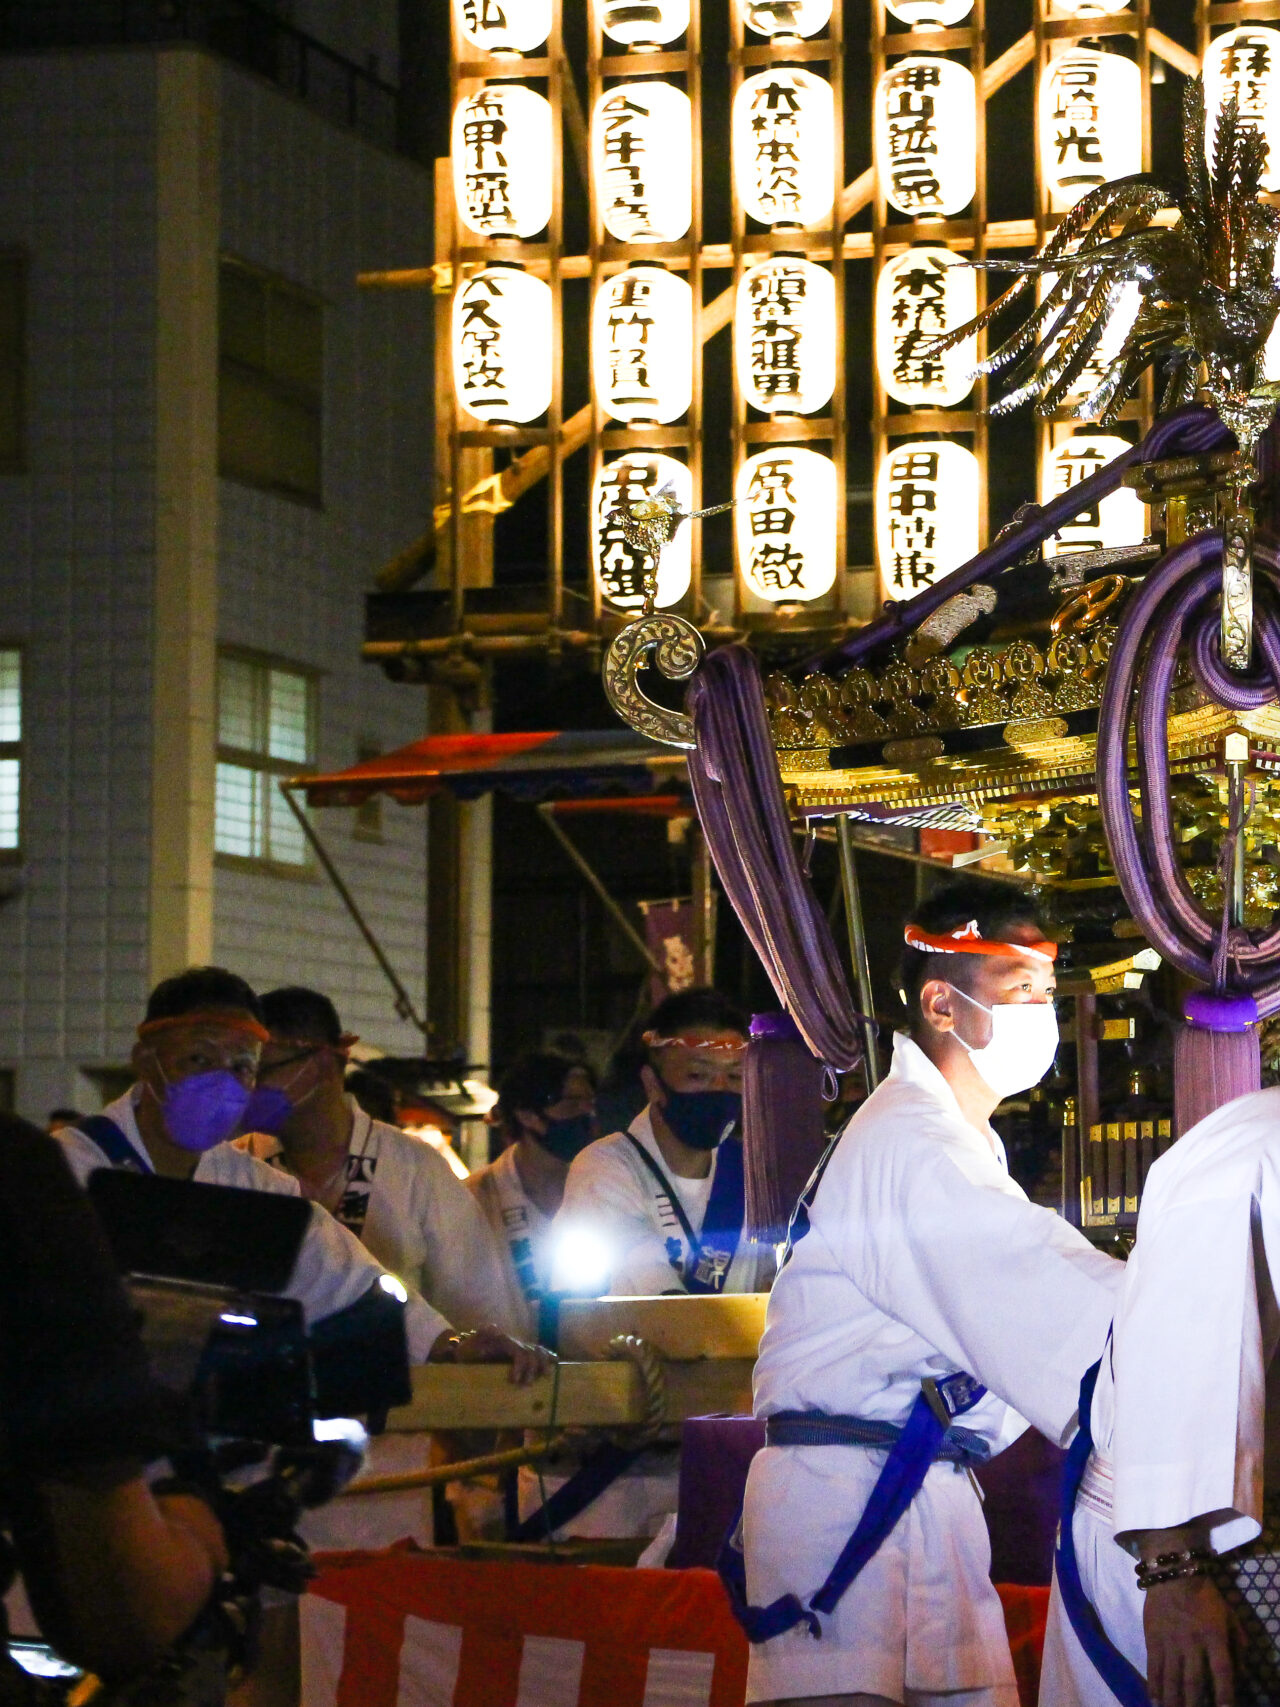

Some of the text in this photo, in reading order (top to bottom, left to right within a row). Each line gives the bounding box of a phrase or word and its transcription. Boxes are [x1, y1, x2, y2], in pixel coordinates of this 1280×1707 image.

[608, 275, 660, 406] 重竹賢一
[749, 459, 806, 590] 原田徹
